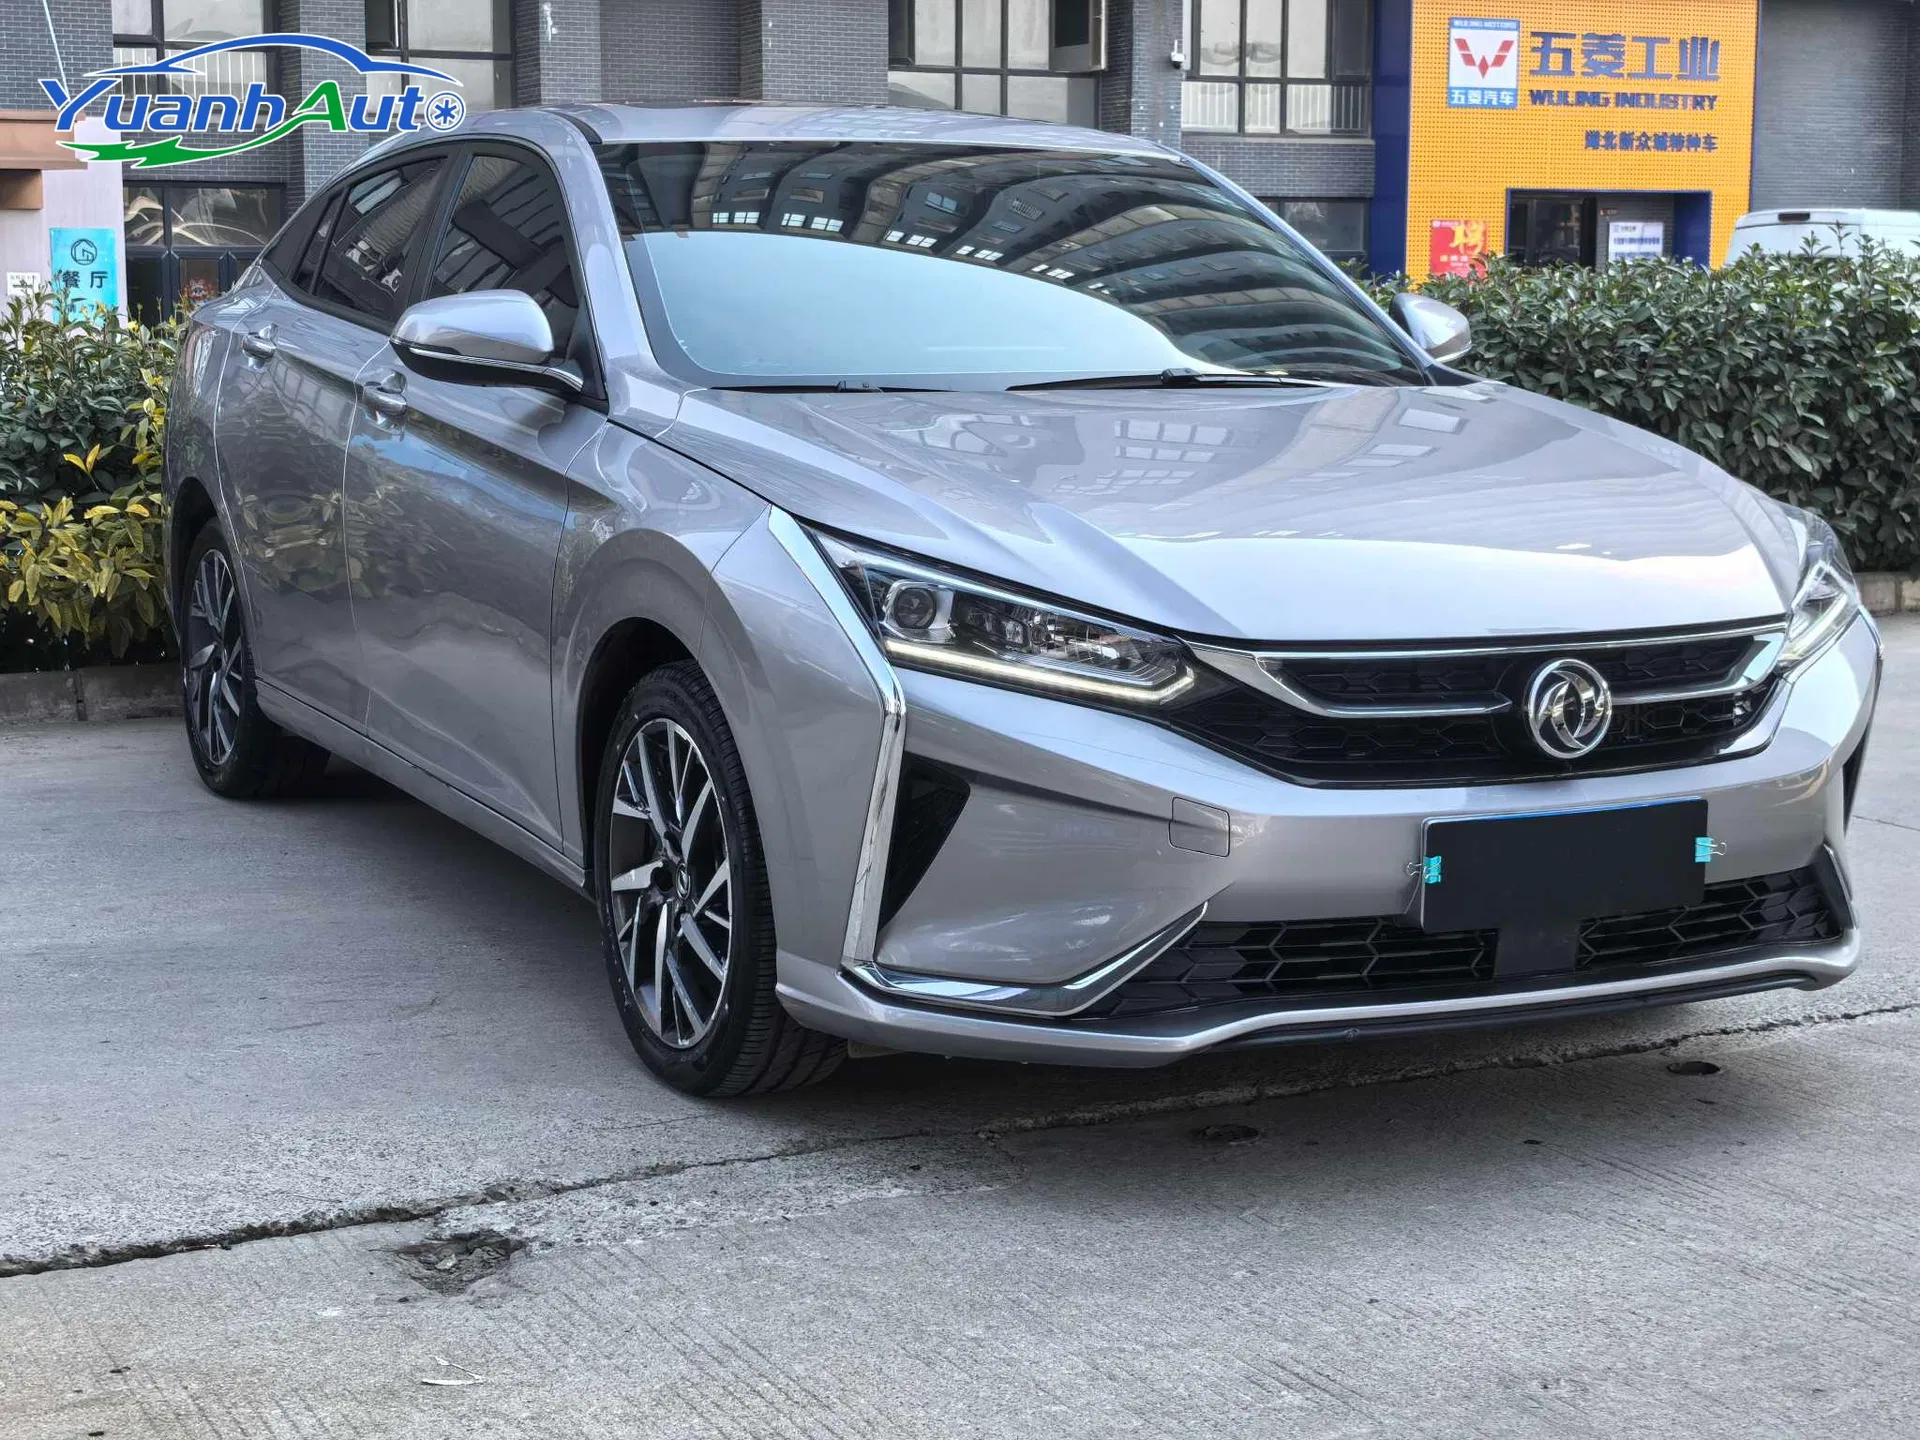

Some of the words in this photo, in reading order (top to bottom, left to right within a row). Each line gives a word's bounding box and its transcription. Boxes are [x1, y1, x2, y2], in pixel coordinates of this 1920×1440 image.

[1529, 32, 1720, 81] 五菱工业
[1451, 89, 1515, 106] 五菱汽车
[1529, 90, 1610, 108] WULING
[1615, 92, 1718, 111] INDUSTRY
[62, 270, 109, 288] 餐厅
